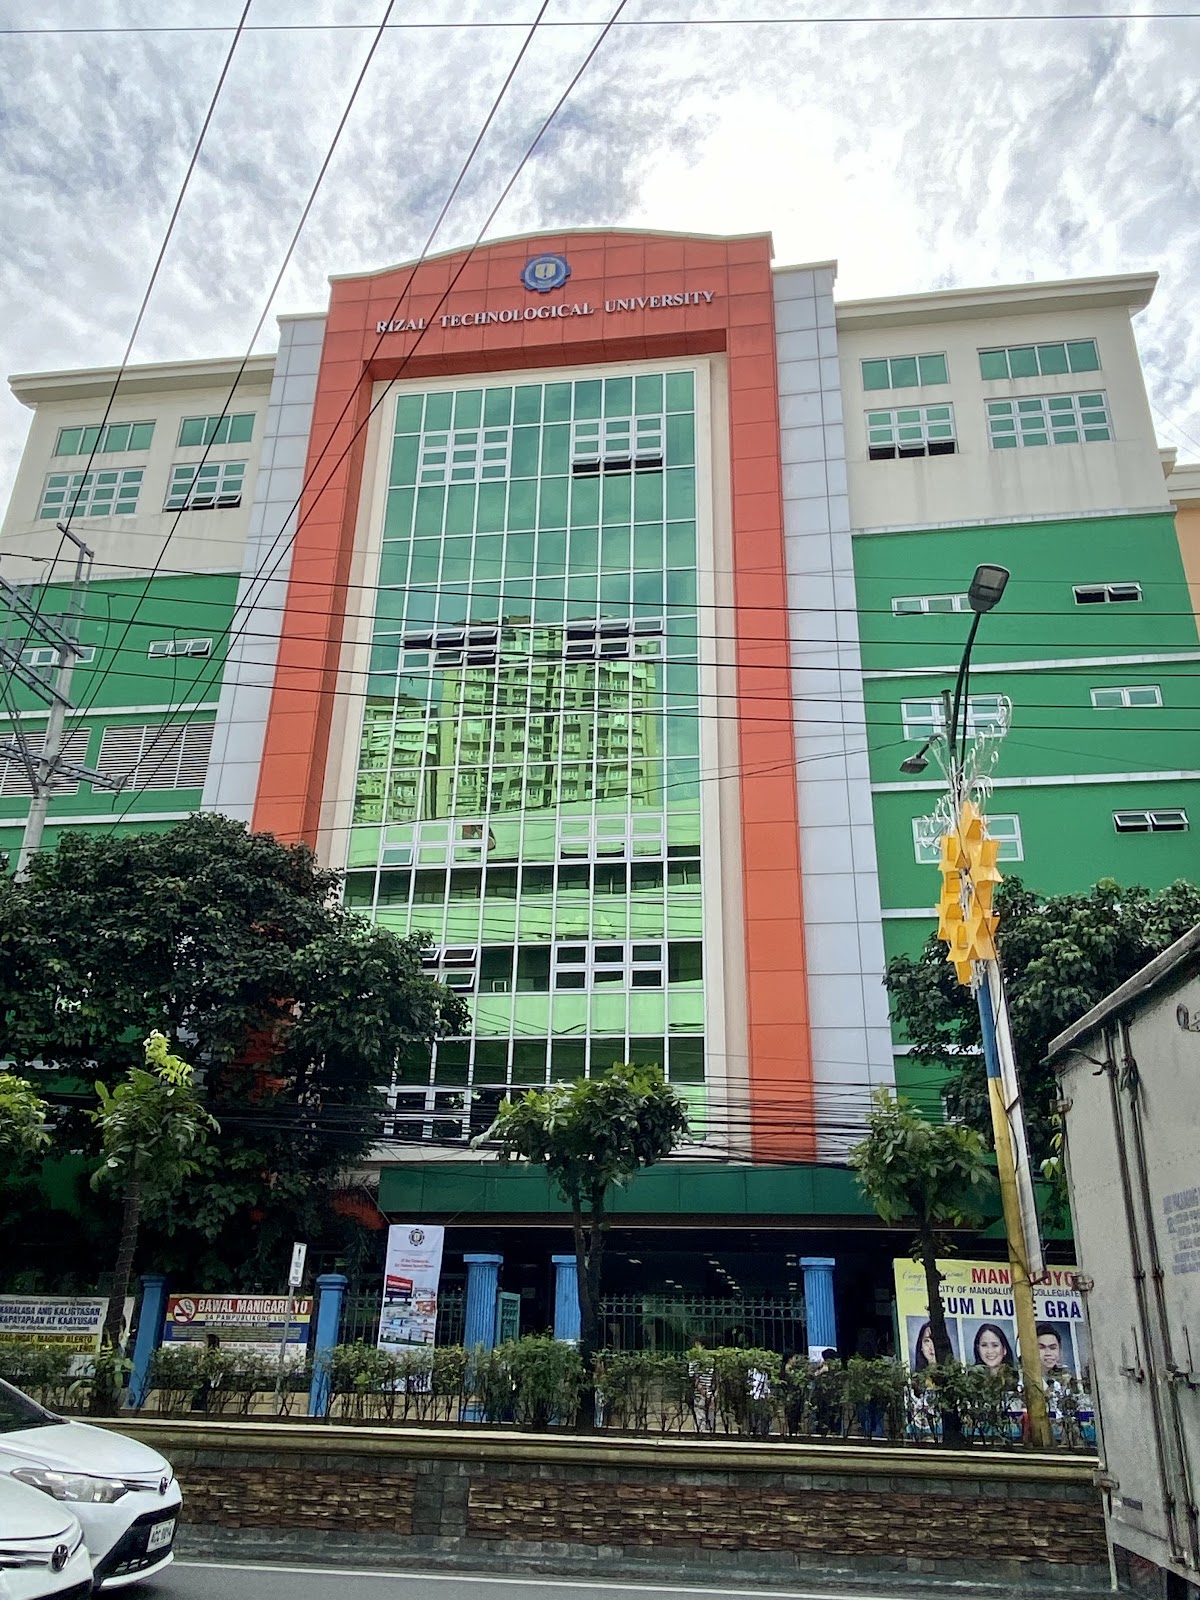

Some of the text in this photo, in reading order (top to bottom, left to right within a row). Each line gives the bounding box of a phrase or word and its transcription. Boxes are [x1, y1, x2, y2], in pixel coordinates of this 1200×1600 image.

[375, 290, 716, 334] RIZAL TECHNOLOGICAL UNIVERSITY
[938, 1285, 954, 1293] CITY
[970, 1287, 1014, 1296] MANDALUY
[1033, 1288, 1080, 1297] COLLEGIATE
[198, 1300, 308, 1314] BAWAL MANIGARIYO
[943, 1297, 975, 1315] UM
[1045, 1300, 1082, 1319] GRA
